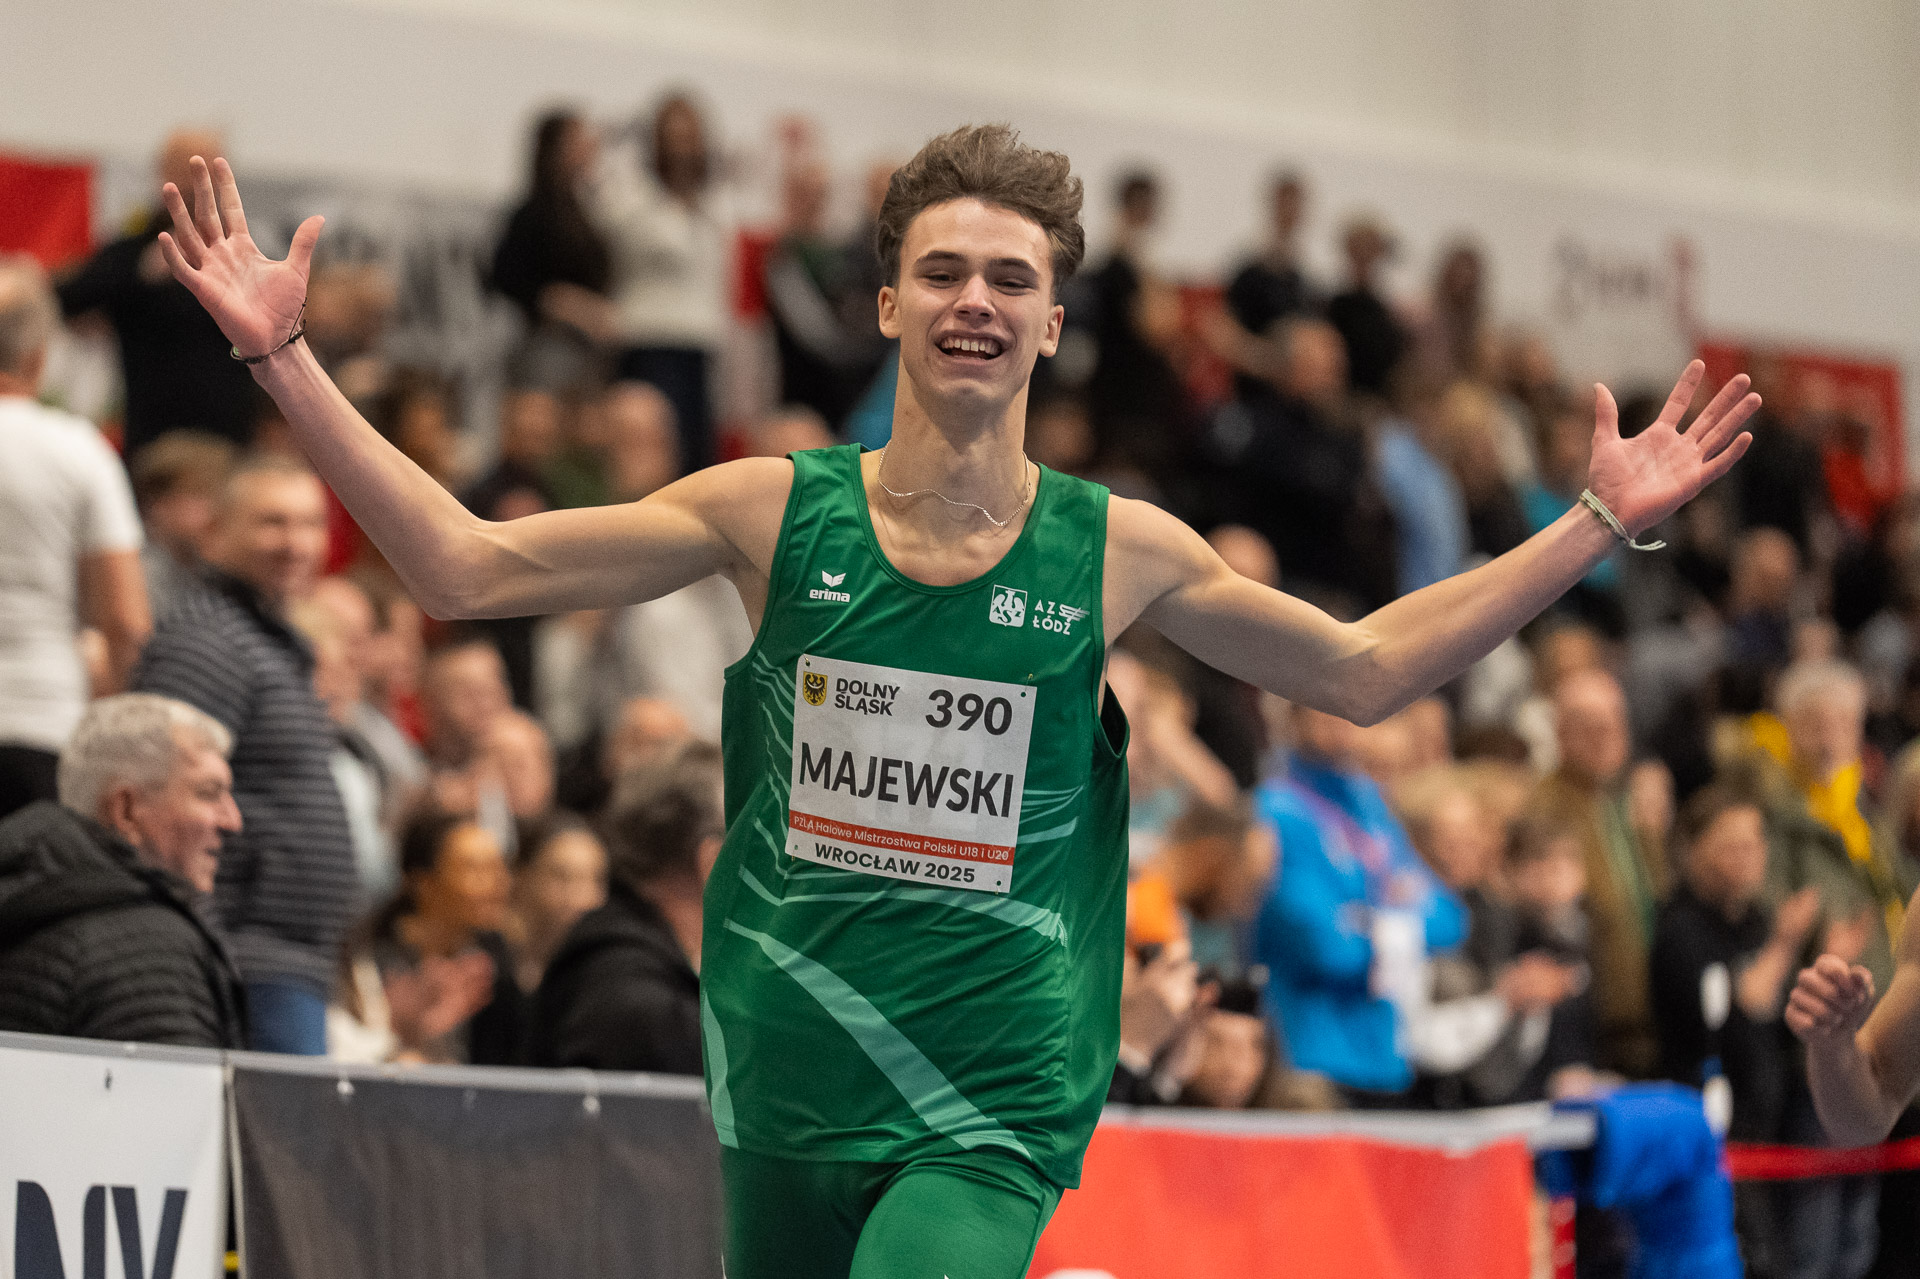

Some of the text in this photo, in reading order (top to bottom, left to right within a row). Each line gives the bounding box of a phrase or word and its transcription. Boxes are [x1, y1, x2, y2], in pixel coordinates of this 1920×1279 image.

[809, 588, 851, 603] erima
[834, 691, 894, 717] ŚLĄSK
[836, 677, 900, 701] DOLNY
[925, 688, 1013, 736] 390
[799, 741, 1014, 818] MAJEWSKI
[794, 815, 1009, 861] PZLA Halowe Mistrzostwa Polski U18 i U20
[815, 842, 976, 883] WROCŁAW 2025
